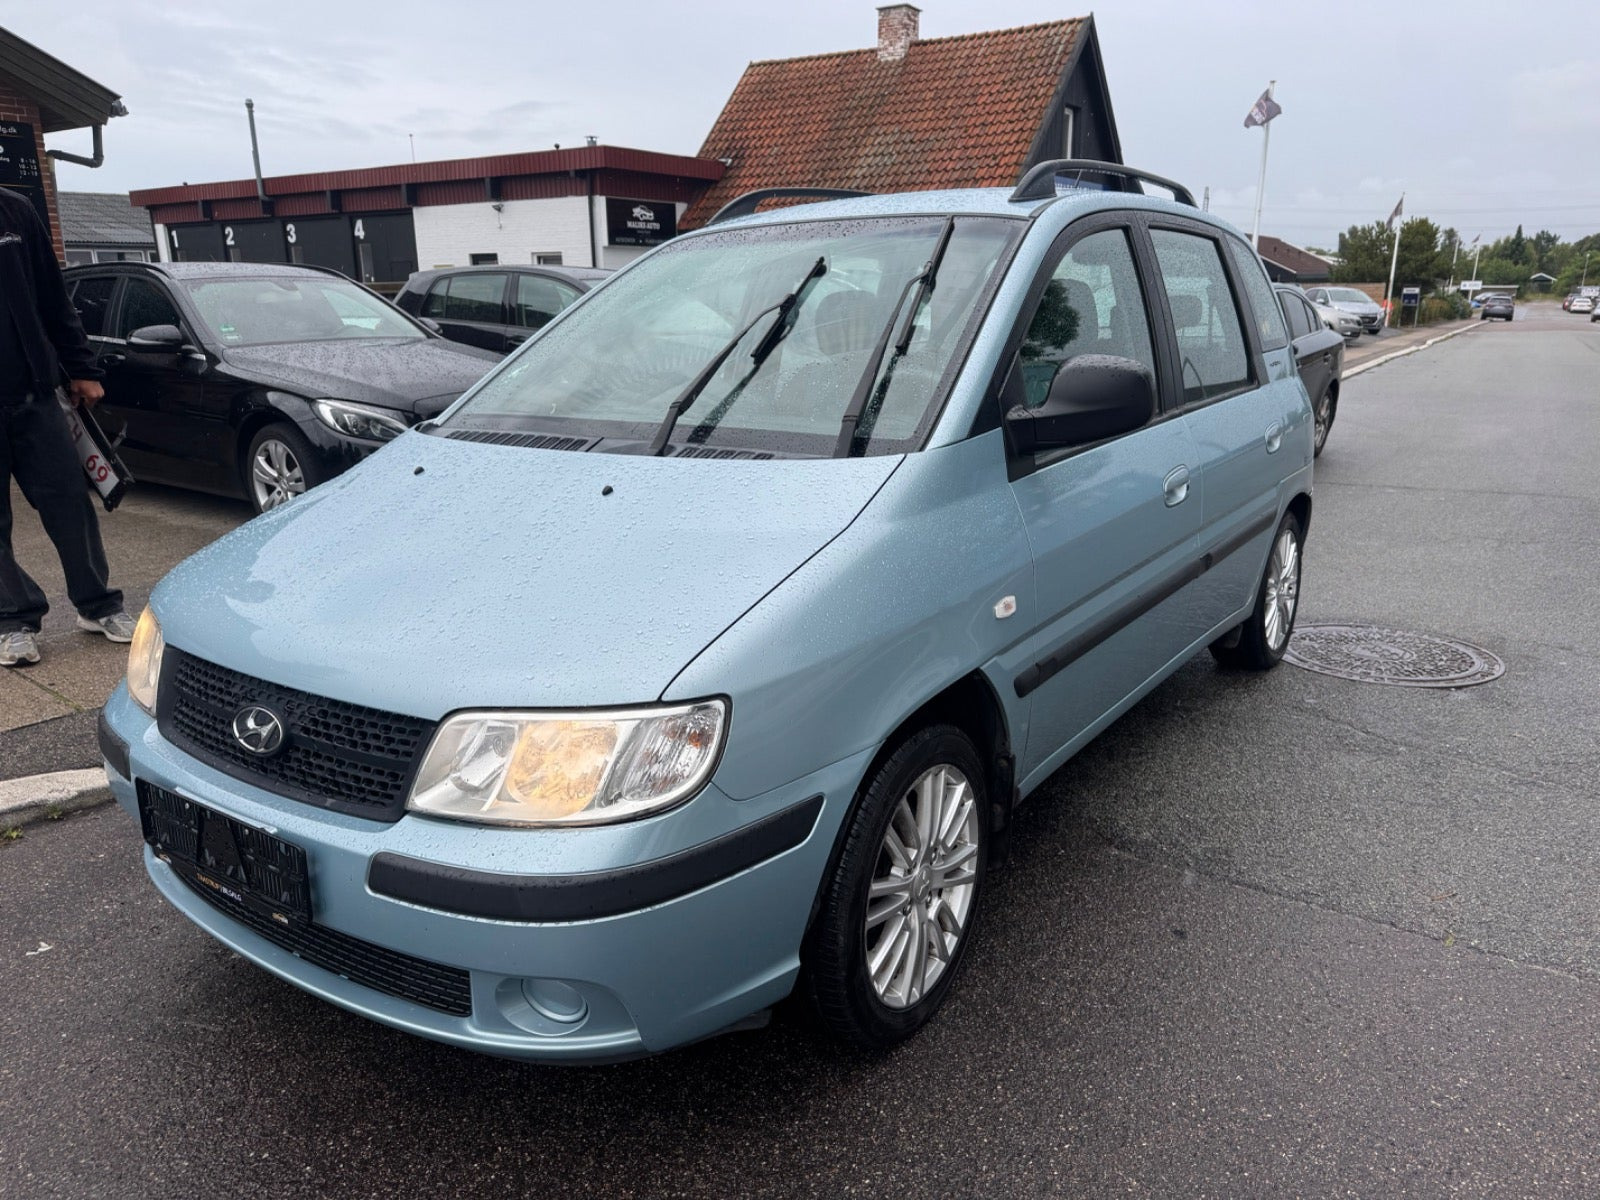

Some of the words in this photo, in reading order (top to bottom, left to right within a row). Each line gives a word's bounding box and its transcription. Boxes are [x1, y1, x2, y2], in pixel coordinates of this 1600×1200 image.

[171, 230, 179, 248] 1
[224, 226, 235, 245] 2
[286, 223, 296, 243] 3
[353, 219, 365, 239] 4
[86, 455, 108, 482] 69
